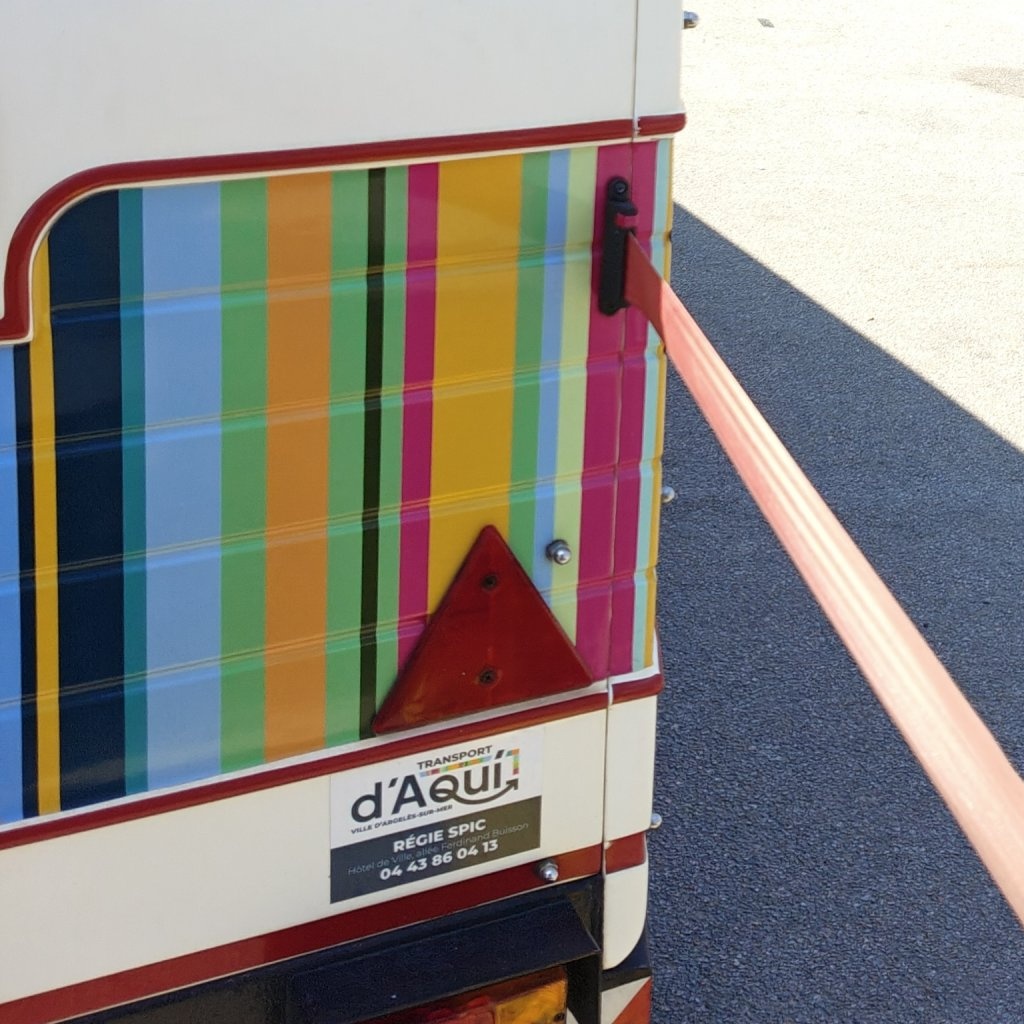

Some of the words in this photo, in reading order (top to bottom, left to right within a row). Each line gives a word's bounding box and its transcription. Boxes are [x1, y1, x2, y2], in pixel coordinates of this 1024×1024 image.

[417, 745, 492, 771] TRANSPORT
[351, 824, 373, 835] VILLE
[393, 829, 444, 853] RÉGIE
[448, 819, 487, 839] SPIC
[376, 858, 389, 868] de
[379, 864, 403, 881] 04
[406, 858, 428, 873] 43
[431, 851, 453, 867] 86
[456, 844, 479, 860] 04
[482, 838, 499, 854] 13
